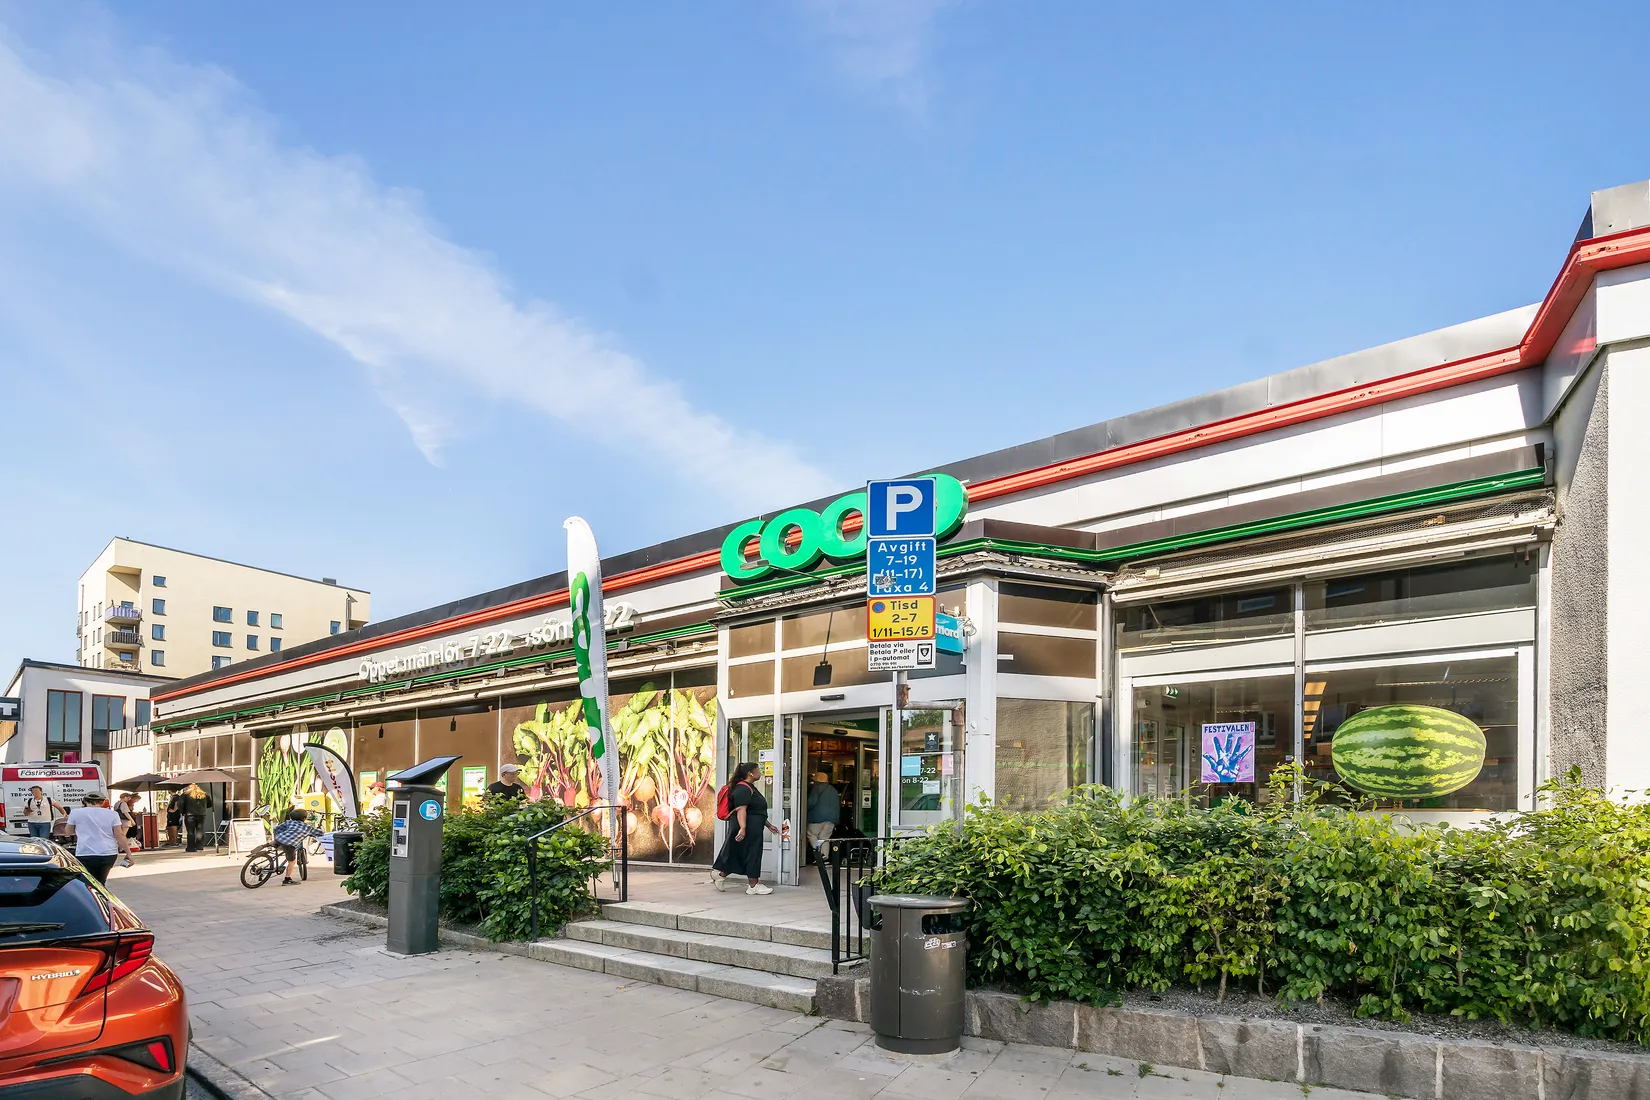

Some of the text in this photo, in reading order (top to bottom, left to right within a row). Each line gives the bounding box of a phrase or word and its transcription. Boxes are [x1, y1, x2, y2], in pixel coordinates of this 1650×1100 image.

[886, 485, 923, 531] P
[877, 541, 926, 554] Avgift
[885, 554, 918, 566] 7-19
[919, 581, 929, 592] 4
[890, 600, 918, 610] Tisd
[892, 613, 917, 623] 2-7
[872, 625, 929, 637] 1/11-15/5
[359, 656, 401, 683] Öppet
[1204, 724, 1250, 733] FESTIVALEN
[31, 971, 76, 980] HYBRID
